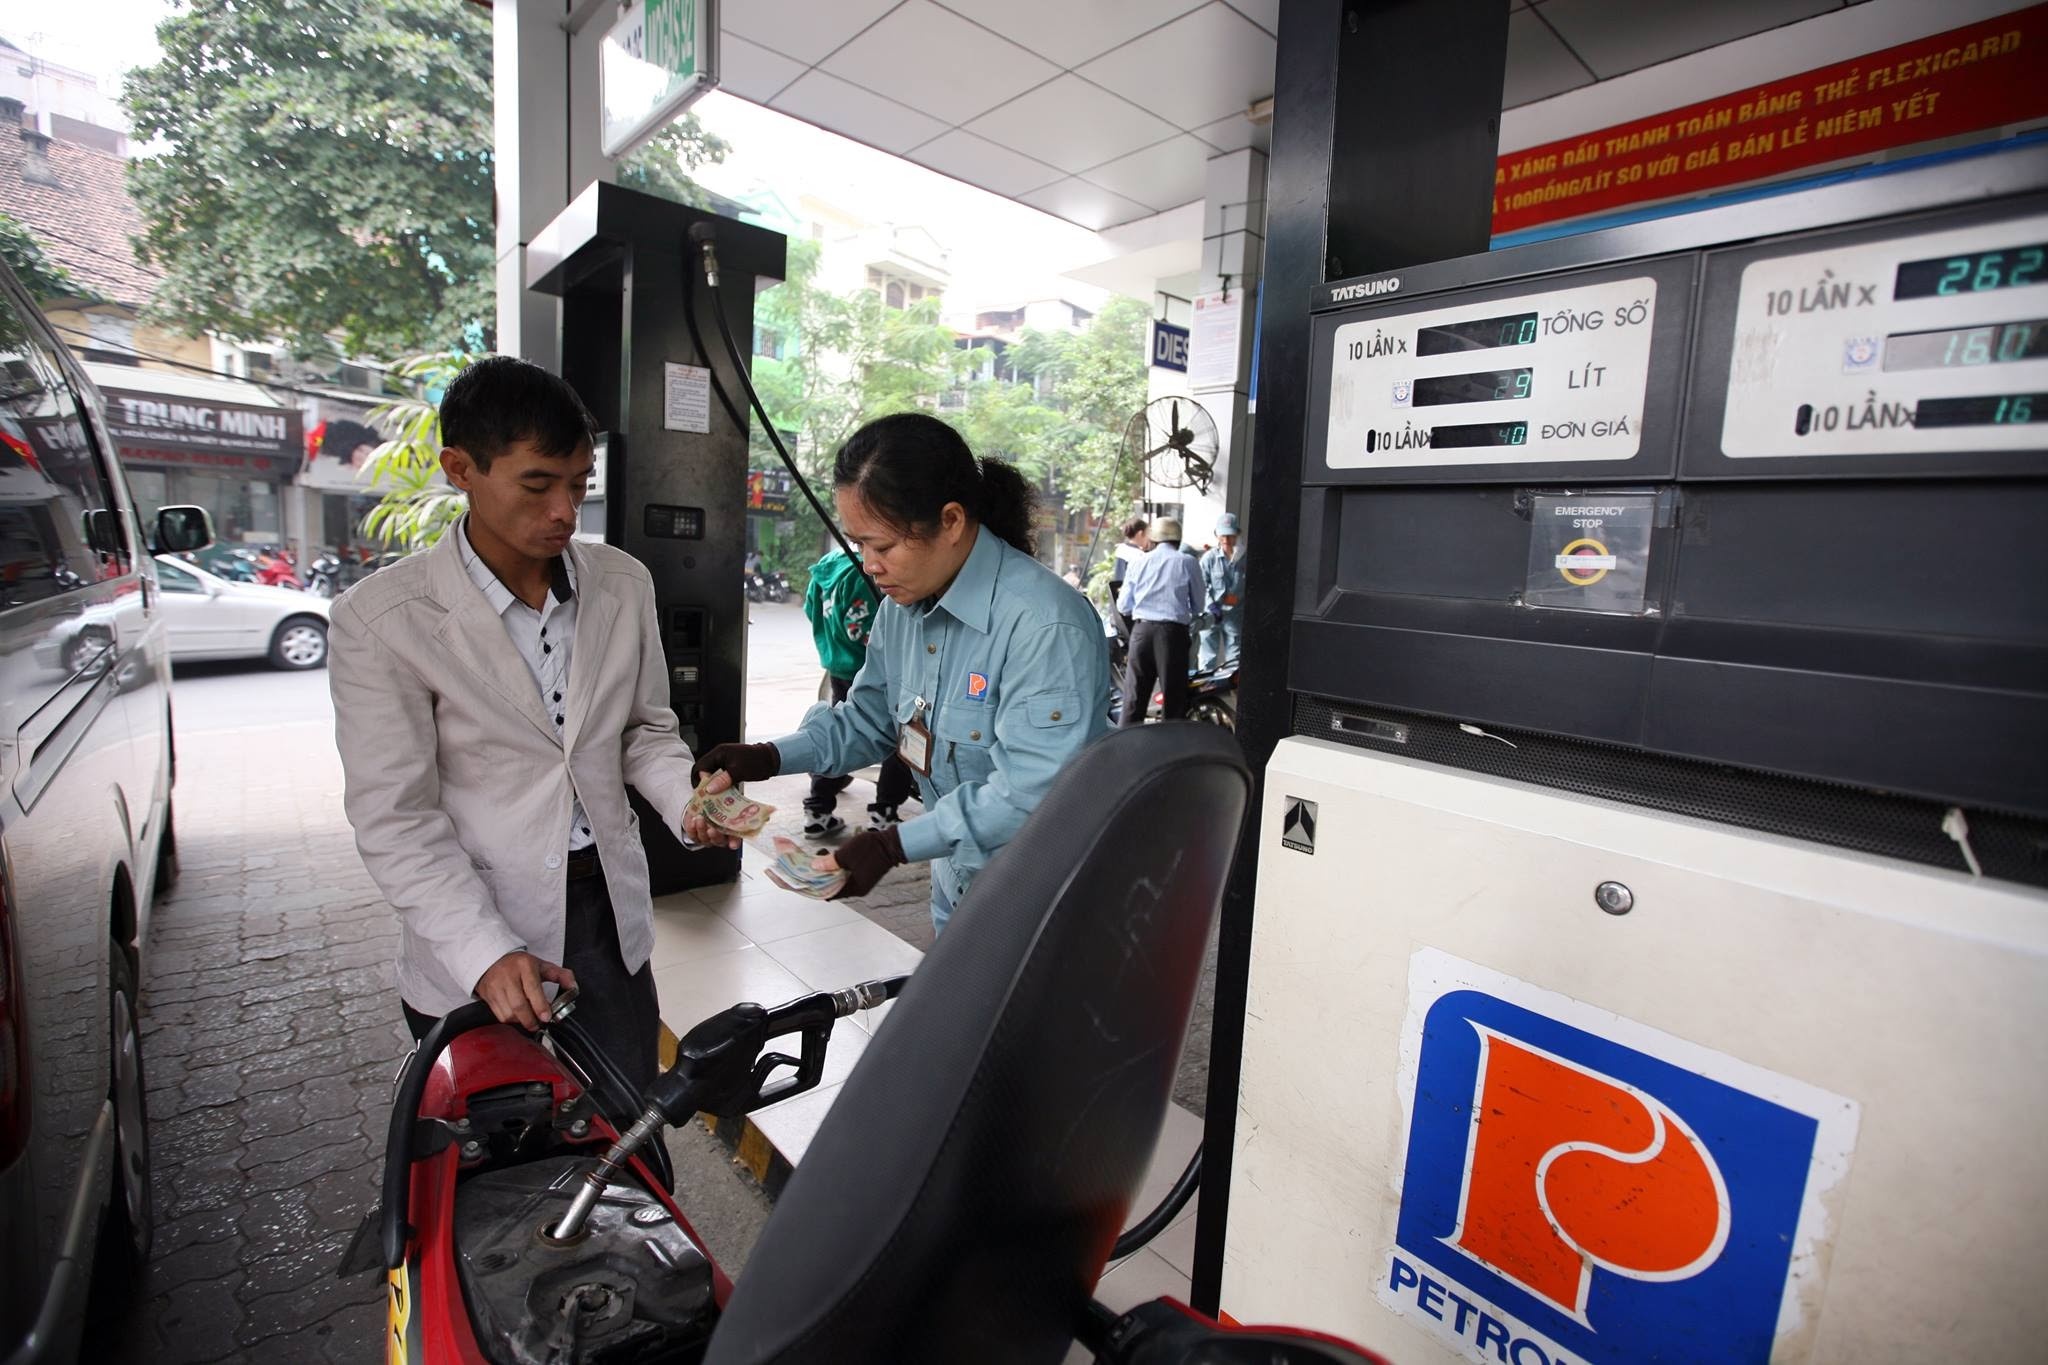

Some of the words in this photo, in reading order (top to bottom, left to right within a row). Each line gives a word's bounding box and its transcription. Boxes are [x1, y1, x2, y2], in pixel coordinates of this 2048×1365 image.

[1606, 124, 1670, 152] THANH
[1677, 108, 1732, 140] TOÁN
[1813, 69, 1860, 105] THẺ
[1867, 30, 2022, 91] FLEXICARD
[1616, 164, 1642, 185] SO
[1647, 153, 1680, 180] VỚI
[1685, 143, 1722, 171] GIÁ
[1727, 132, 1775, 161] BÁN
[1781, 117, 1809, 149] LẺ
[1815, 105, 1882, 140] NIÊM
[1892, 88, 1941, 122] YẾT
[1937, 250, 2043, 297] 262
[1331, 277, 1399, 302] TATSUNO
[1767, 291, 1792, 316] 10
[1800, 269, 1850, 313] LẦN
[1543, 309, 1604, 335] TỔNG
[1615, 298, 1650, 327] SỐ
[1349, 341, 1362, 360] 10
[1367, 328, 1394, 358] LẦN
[1568, 362, 1607, 390] LÍT
[119, 397, 215, 431] TRUNG
[219, 410, 286, 440] MINH
[1814, 407, 1838, 432] 10
[1994, 397, 2032, 424] 16
[1377, 431, 1391, 451] 10
[1541, 421, 1586, 440] ĐƠN
[1592, 415, 1630, 438] GIÁ
[1555, 506, 1625, 516] EMERGENCY
[1573, 519, 1603, 529] STOP
[1389, 1256, 1568, 1365] PETRO
